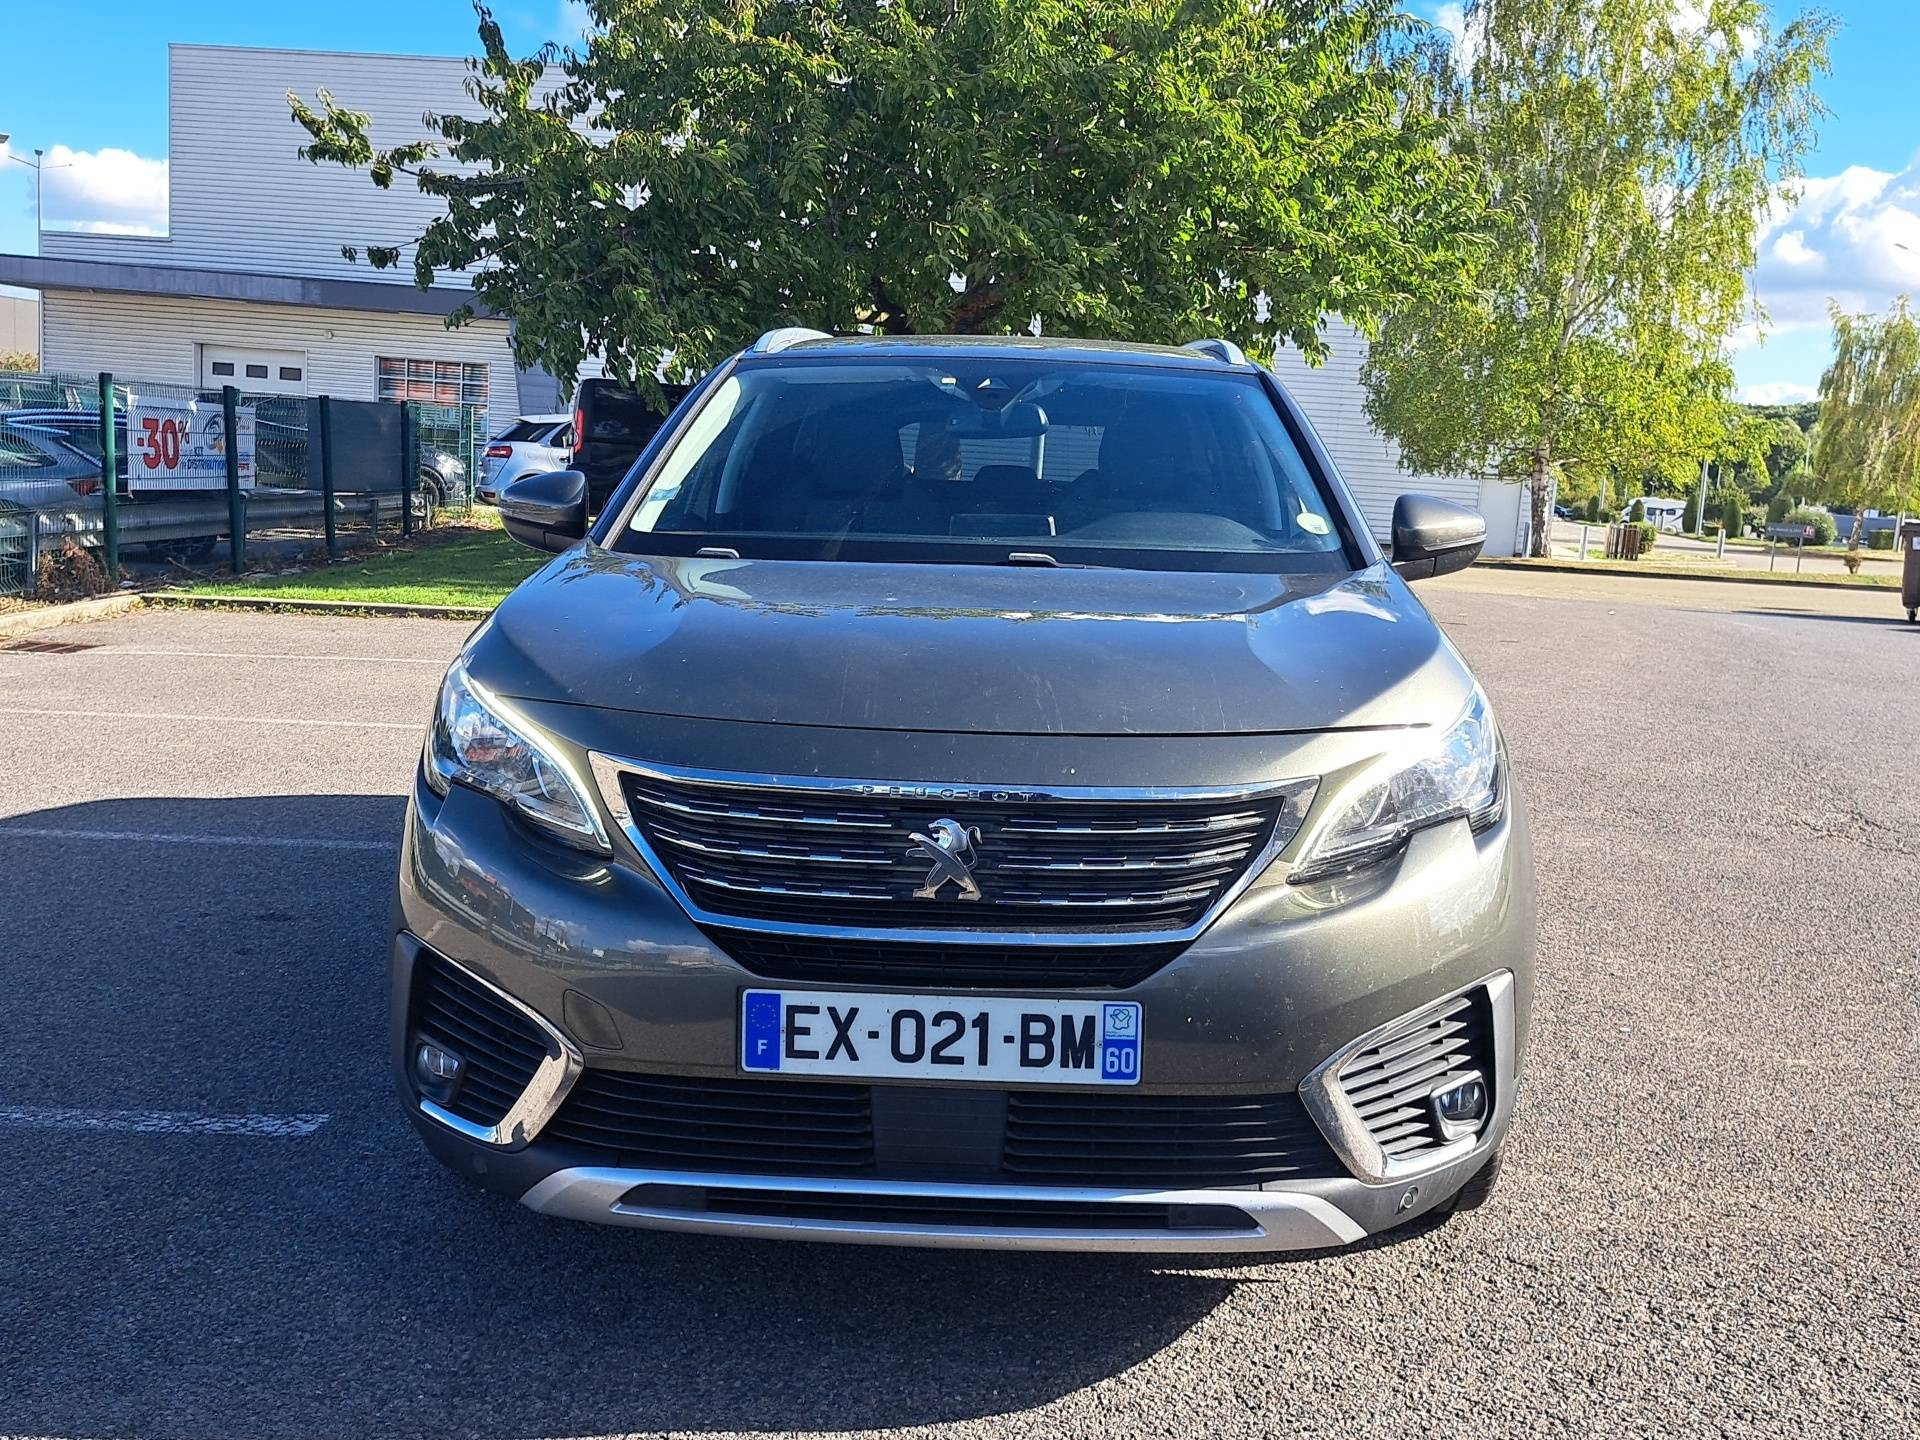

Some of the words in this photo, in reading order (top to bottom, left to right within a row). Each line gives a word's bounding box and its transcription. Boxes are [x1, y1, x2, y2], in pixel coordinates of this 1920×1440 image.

[862, 785, 1034, 803] PEUGEOT
[757, 1039, 768, 1056] F
[784, 1004, 1096, 1070] EX-021-BM
[1105, 1047, 1135, 1074] 60
